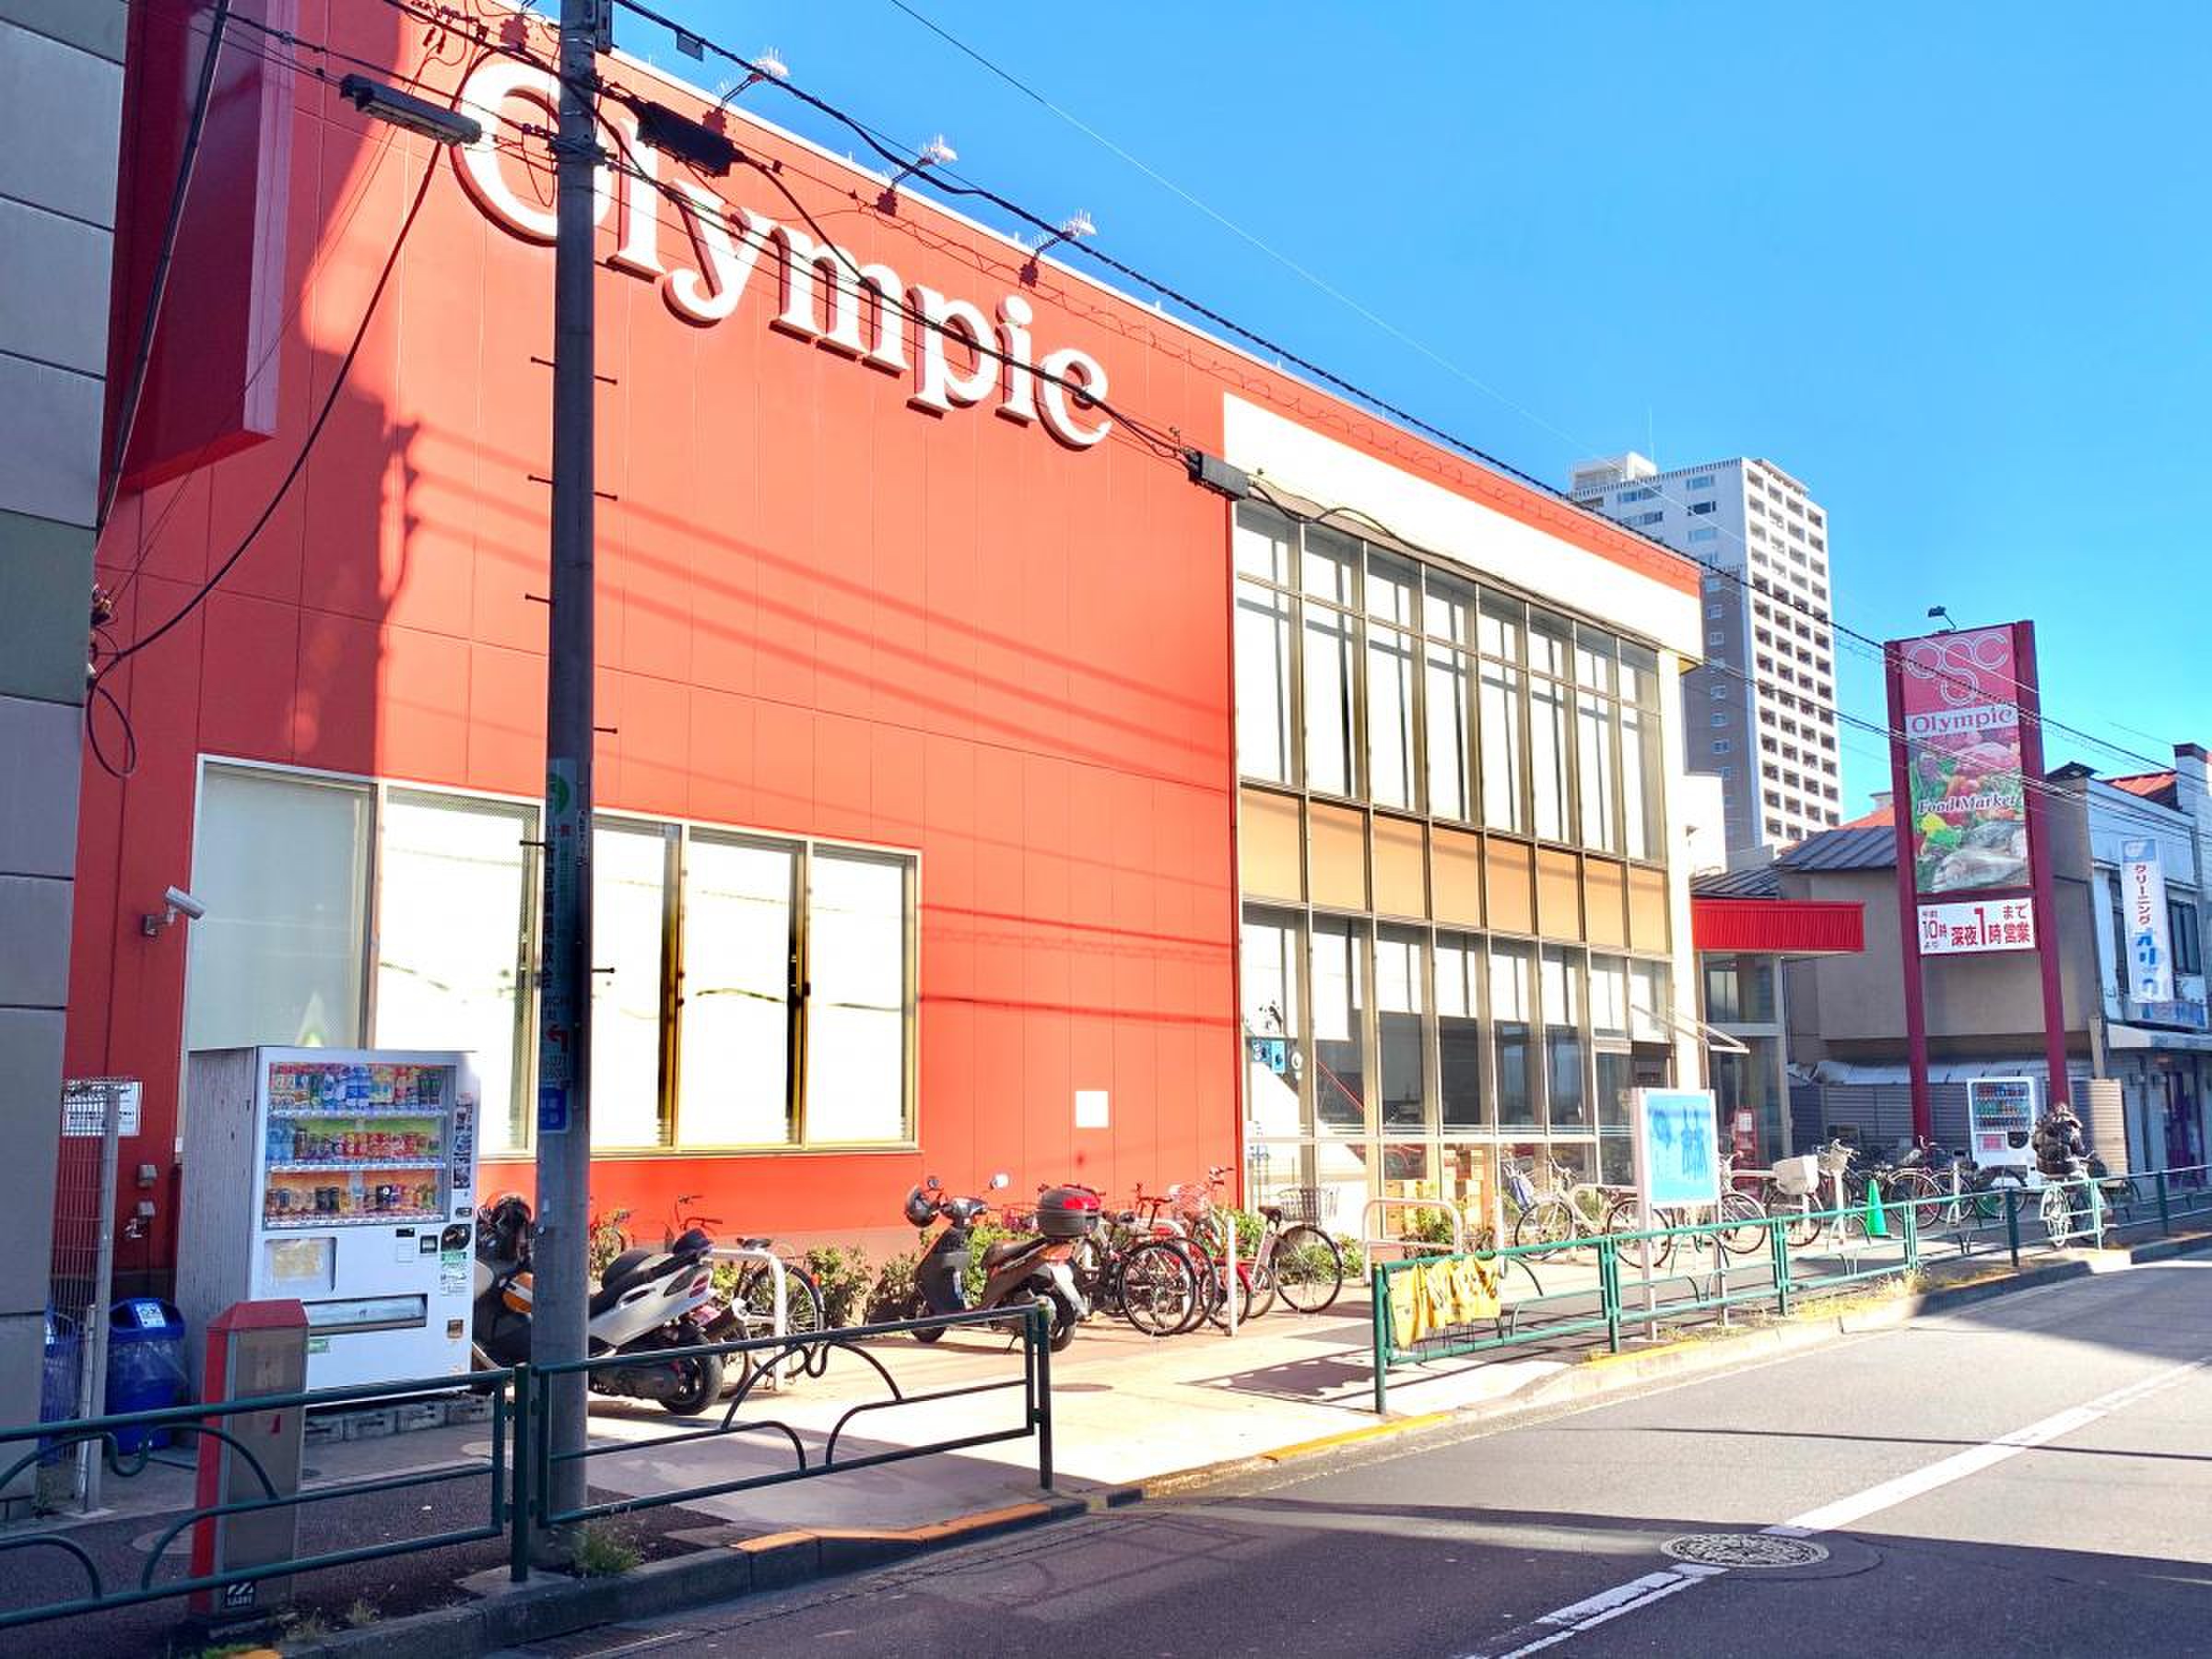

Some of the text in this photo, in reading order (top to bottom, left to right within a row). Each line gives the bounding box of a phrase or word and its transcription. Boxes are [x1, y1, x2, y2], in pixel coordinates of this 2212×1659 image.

[451, 61, 1113, 450] Olympic
[1911, 708, 2014, 734] Olympic
[1917, 792, 2024, 814] Food Market
[2135, 864, 2151, 925] クリーニング
